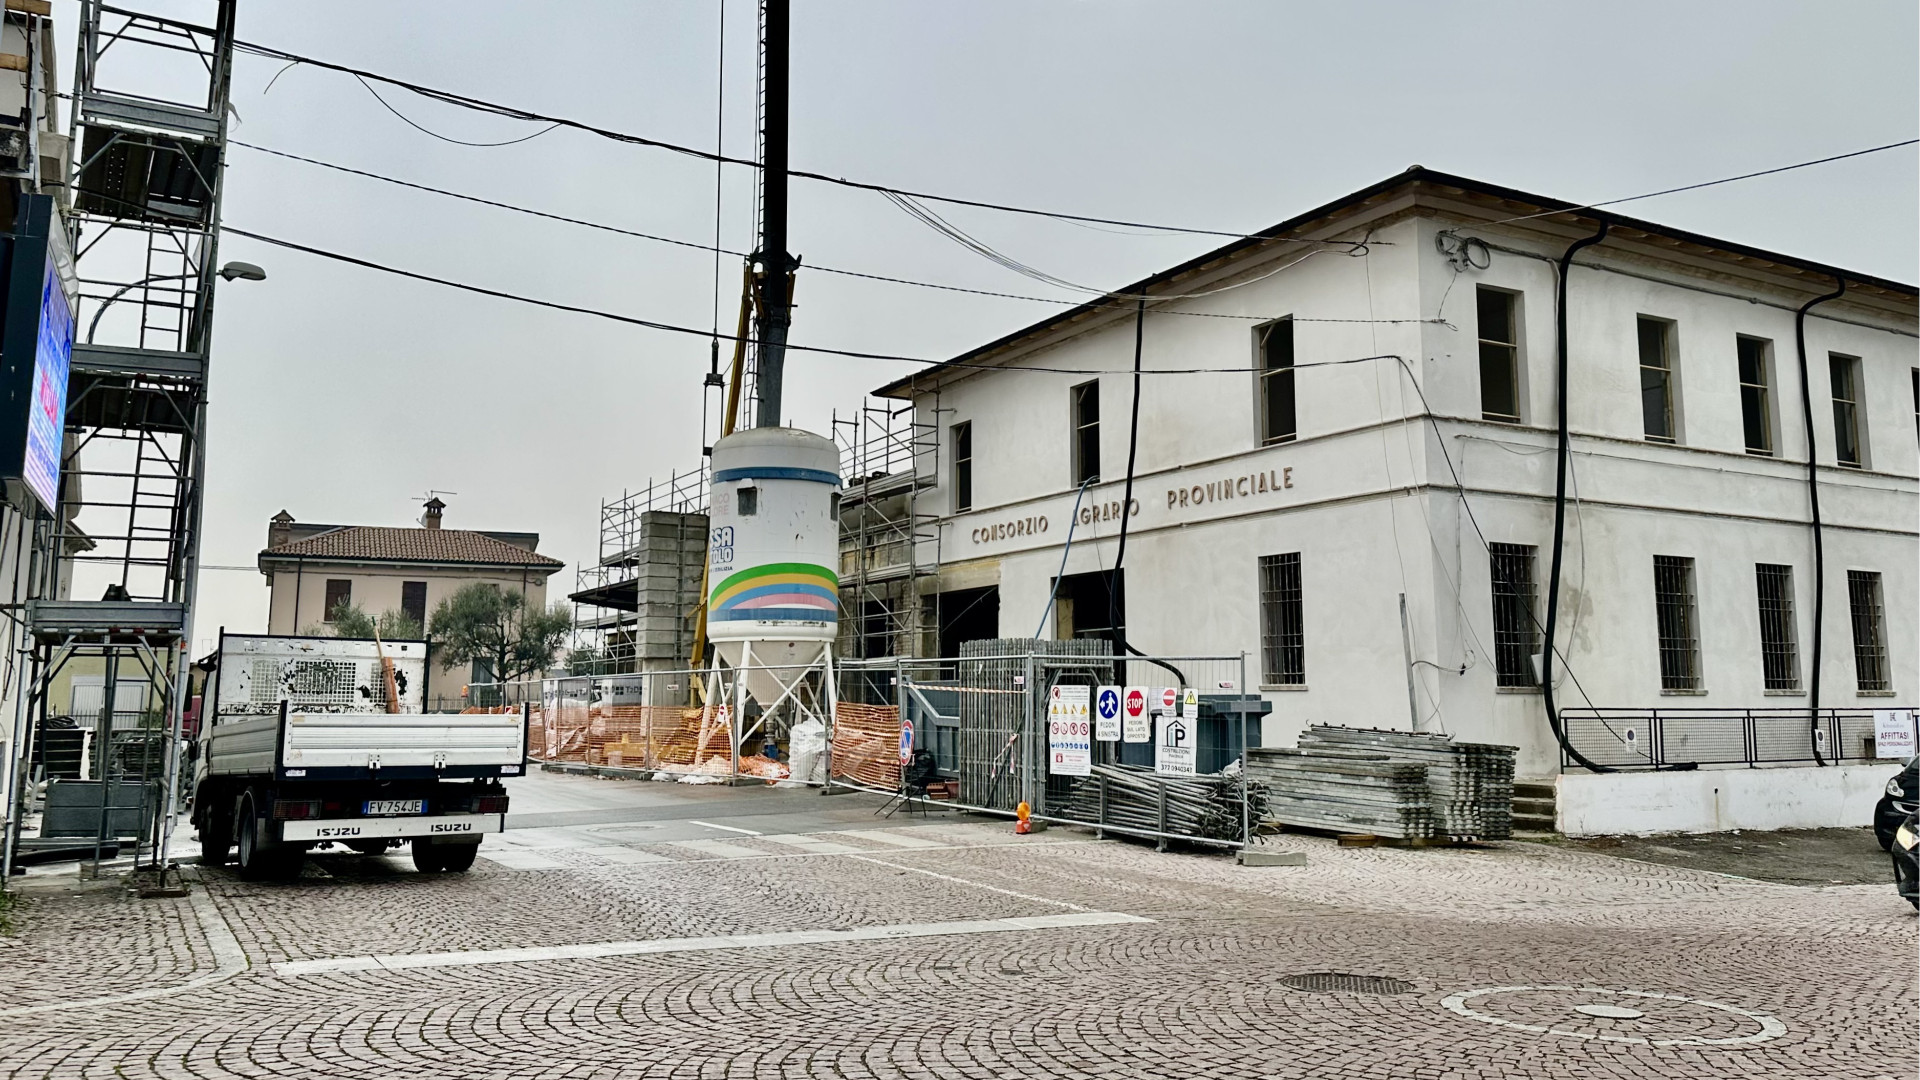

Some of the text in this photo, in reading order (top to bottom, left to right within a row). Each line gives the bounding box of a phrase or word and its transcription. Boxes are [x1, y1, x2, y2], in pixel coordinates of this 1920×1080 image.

[972, 515, 1049, 544] CONSORZIO
[1167, 466, 1294, 509] PROVINCIALE
[1127, 698, 1143, 709] STOP
[1880, 731, 1909, 740] AFFITTASI
[430, 823, 472, 832] ISUZU
